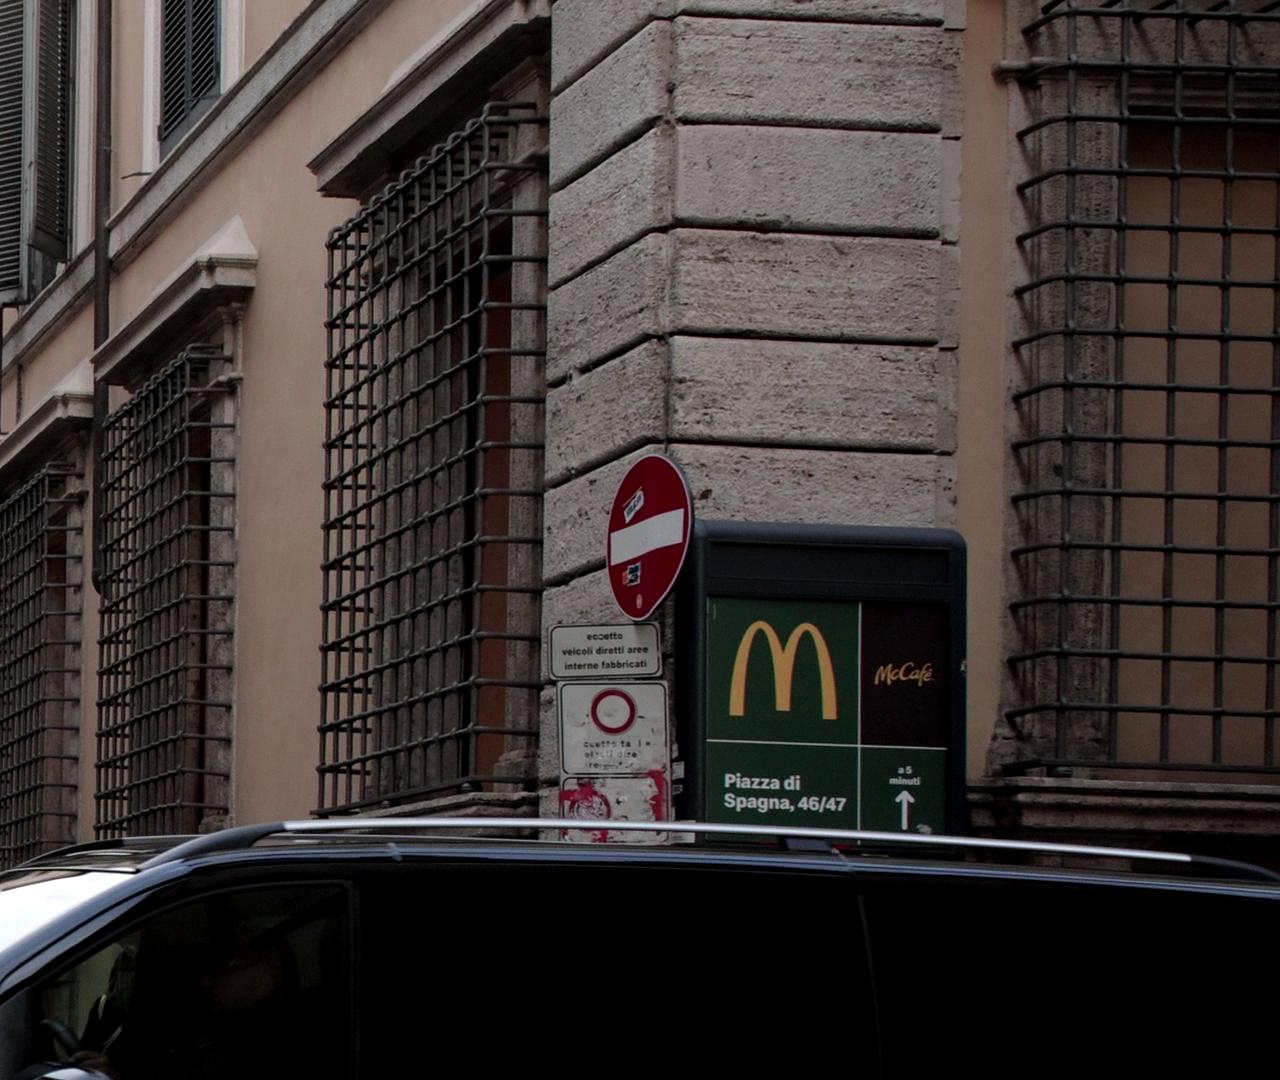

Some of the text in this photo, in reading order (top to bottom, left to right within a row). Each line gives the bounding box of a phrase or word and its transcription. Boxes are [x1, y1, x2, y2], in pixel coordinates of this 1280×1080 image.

[587, 632, 623, 640] eccetto
[562, 645, 648, 655] veicoli diretti aree
[564, 659, 647, 670] interne fabbricati
[874, 662, 933, 687] McCafé
[906, 766, 912, 774] 5
[724, 772, 801, 790] Piazza di
[889, 776, 921, 785] minuti
[724, 793, 847, 813] Spagna, 46/47
